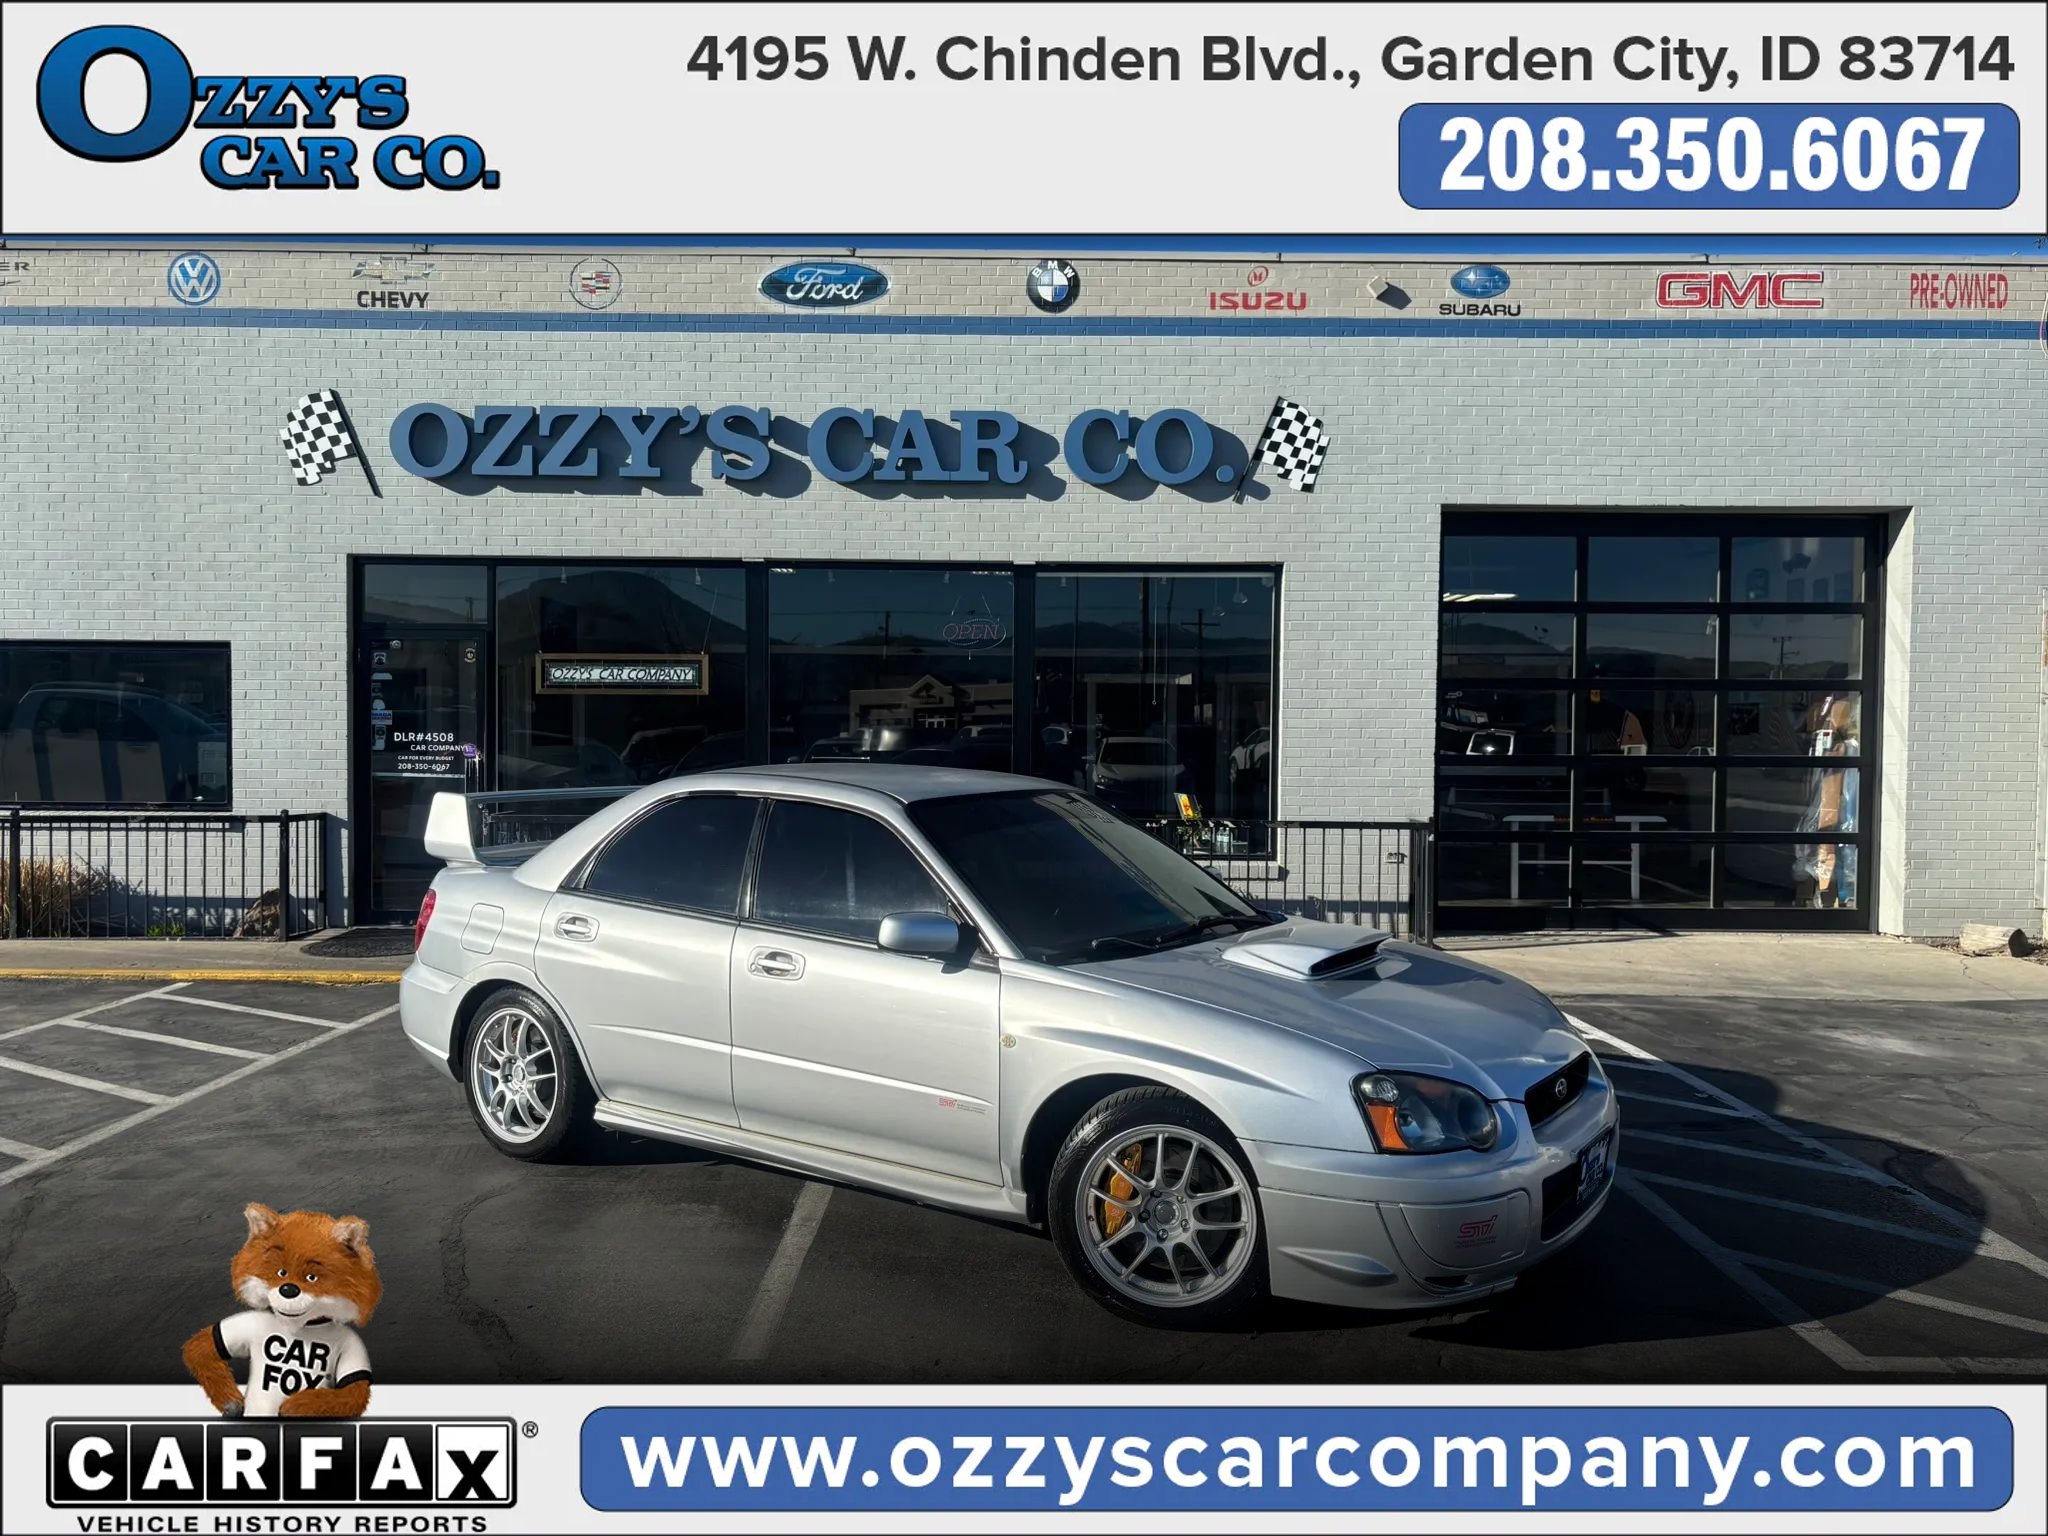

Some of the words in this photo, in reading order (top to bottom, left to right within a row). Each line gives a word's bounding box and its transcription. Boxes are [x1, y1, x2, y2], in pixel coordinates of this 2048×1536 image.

[1032, 260, 1075, 278] BMW
[787, 267, 864, 302] Ford
[1656, 272, 1824, 310] GMC
[1910, 272, 2009, 310] PRE-OWNED
[357, 291, 429, 308] CHEVY
[1209, 292, 1307, 311] ISUZU
[1439, 303, 1521, 317] SUBARU
[390, 402, 772, 482] OZZY'S
[807, 406, 1028, 484] CAR
[1064, 408, 1236, 486] CO.
[943, 623, 999, 640] OPEN
[600, 667, 624, 680] CAR
[627, 668, 693, 682] COMPANY
[393, 732, 454, 742] DLR#4508
[427, 744, 465, 752] COMPANY
[397, 763, 450, 771] 208-350-6067
